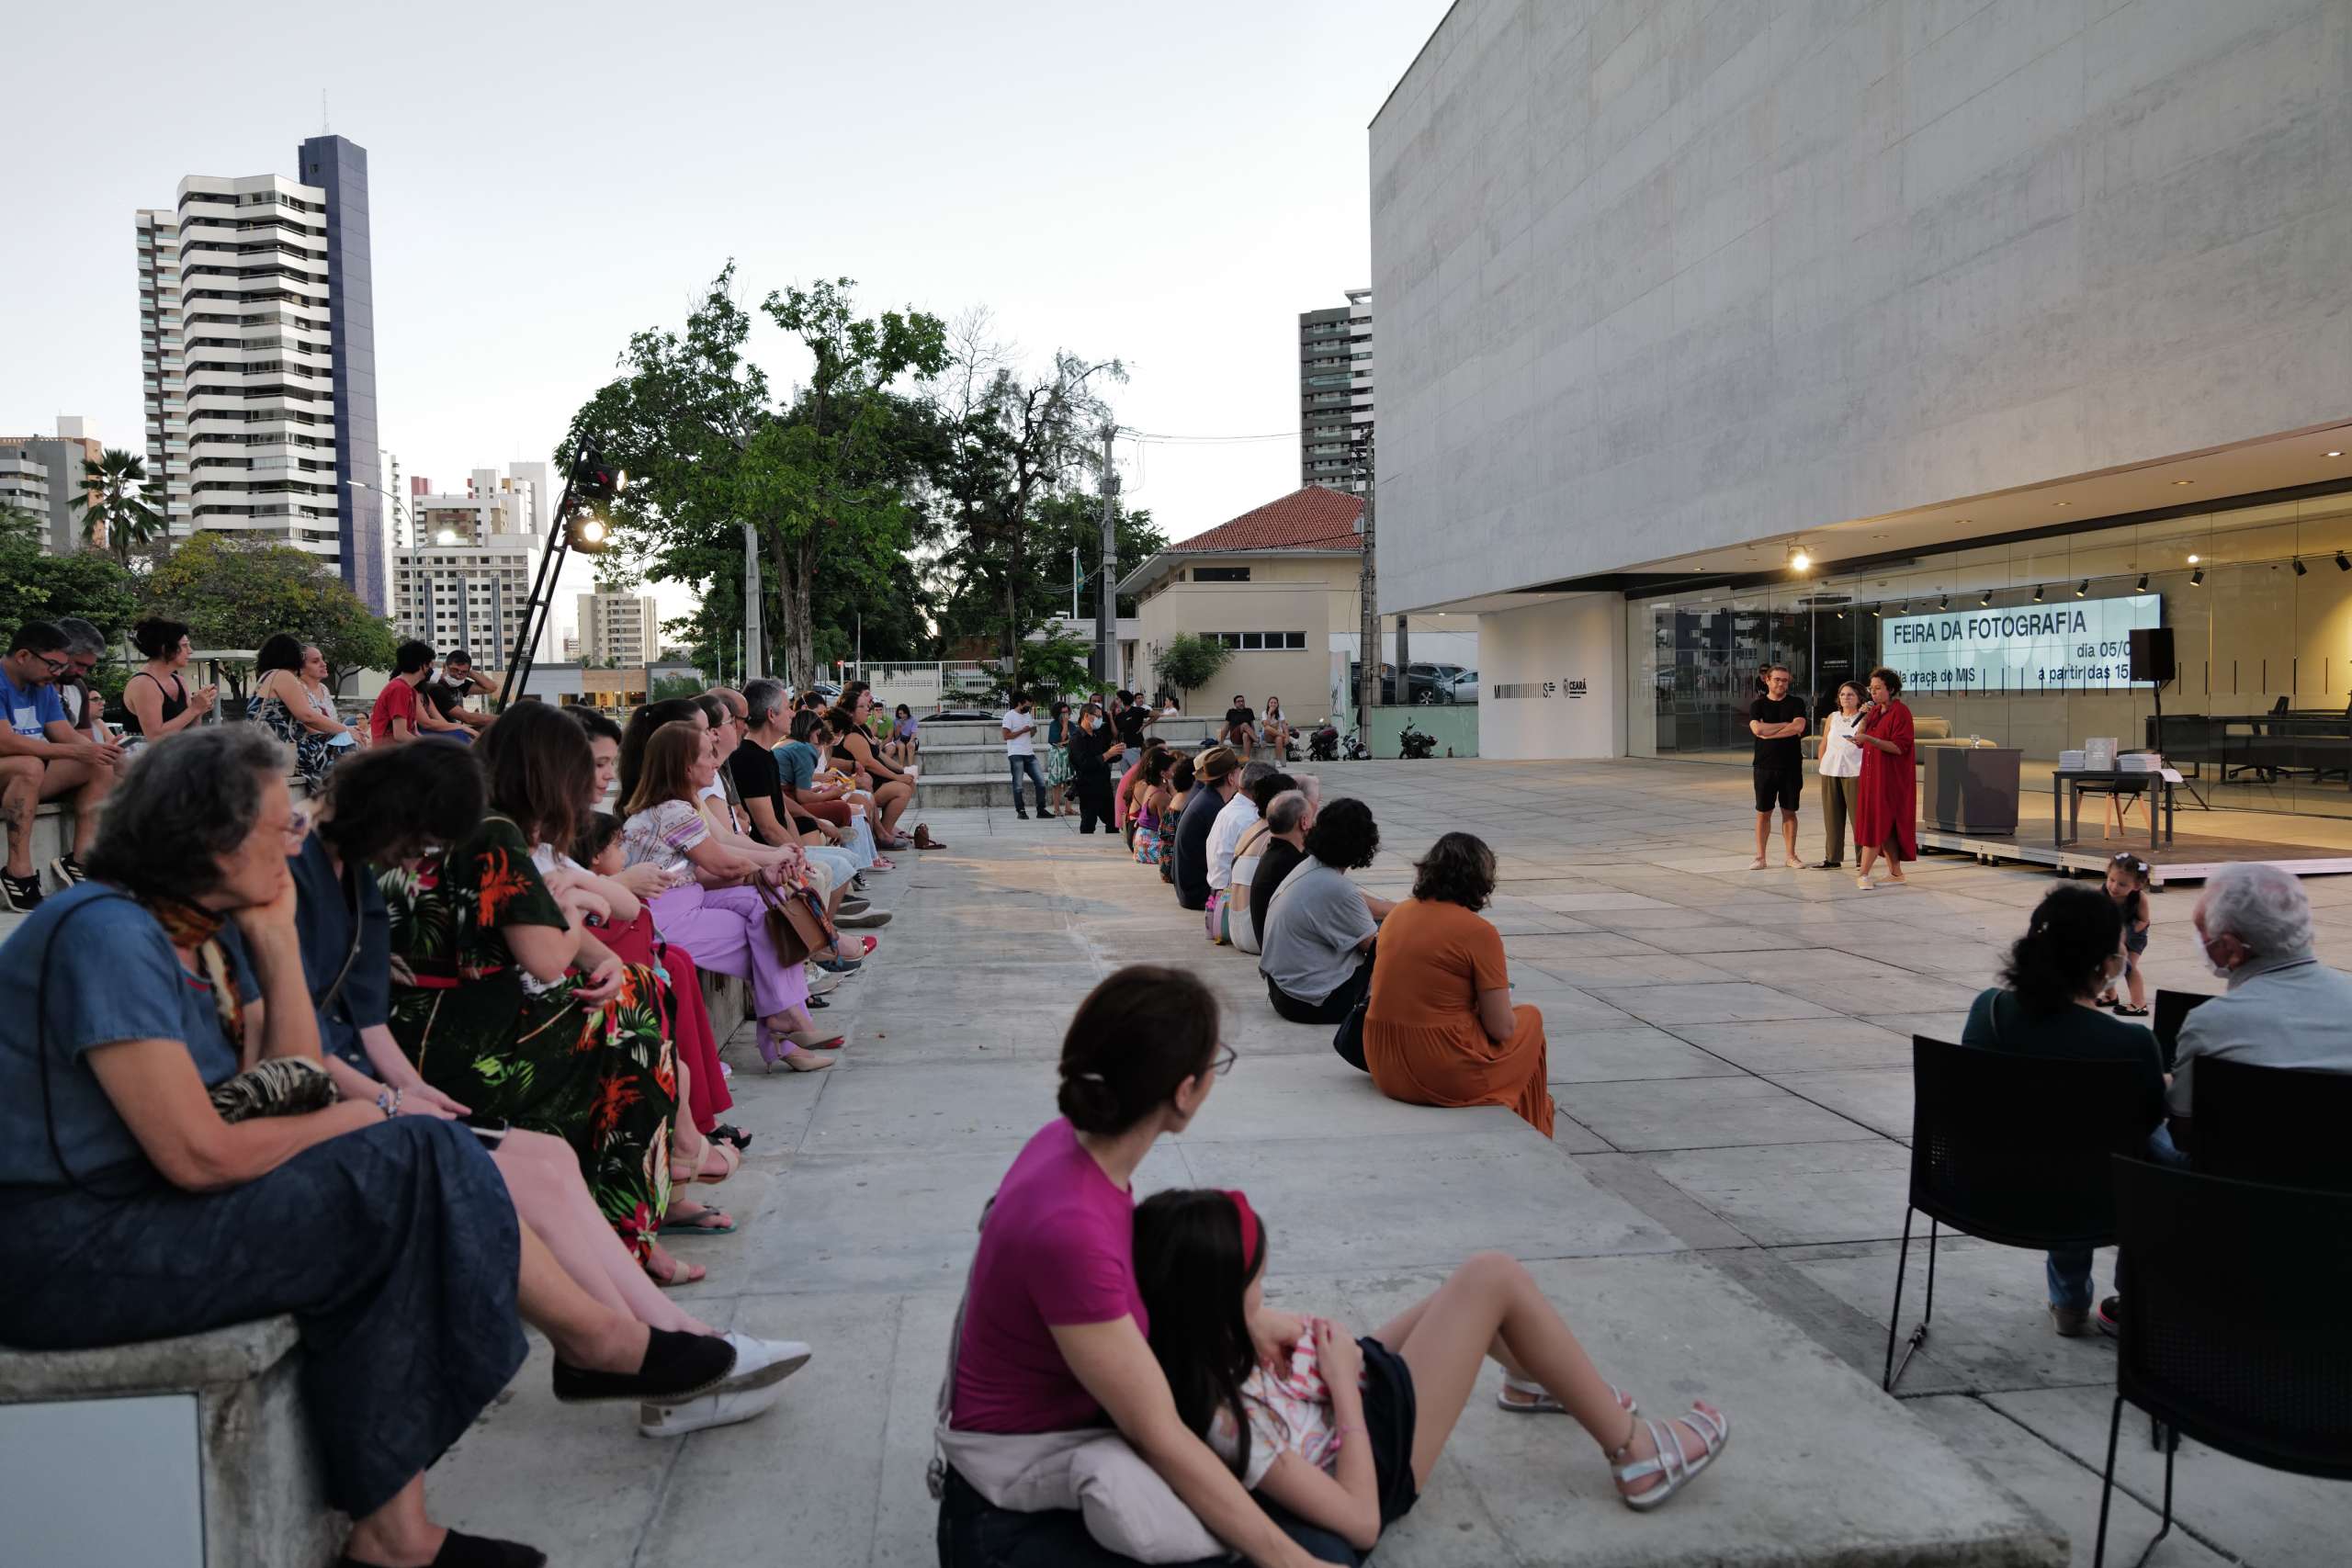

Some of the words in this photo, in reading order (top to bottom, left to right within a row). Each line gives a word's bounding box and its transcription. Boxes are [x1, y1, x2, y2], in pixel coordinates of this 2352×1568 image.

[1894, 622, 1936, 644] FEIRA
[1940, 620, 1963, 641] DA
[1968, 610, 2086, 640] FOTOGRAFIA
[2076, 642, 2096, 658] dia
[1909, 671, 1938, 687] praça
[1940, 669, 1953, 682] do
[1956, 667, 1975, 682] MIS
[2038, 667, 2045, 681] a
[2050, 664, 2083, 683] partir
[2087, 664, 2110, 680] das
